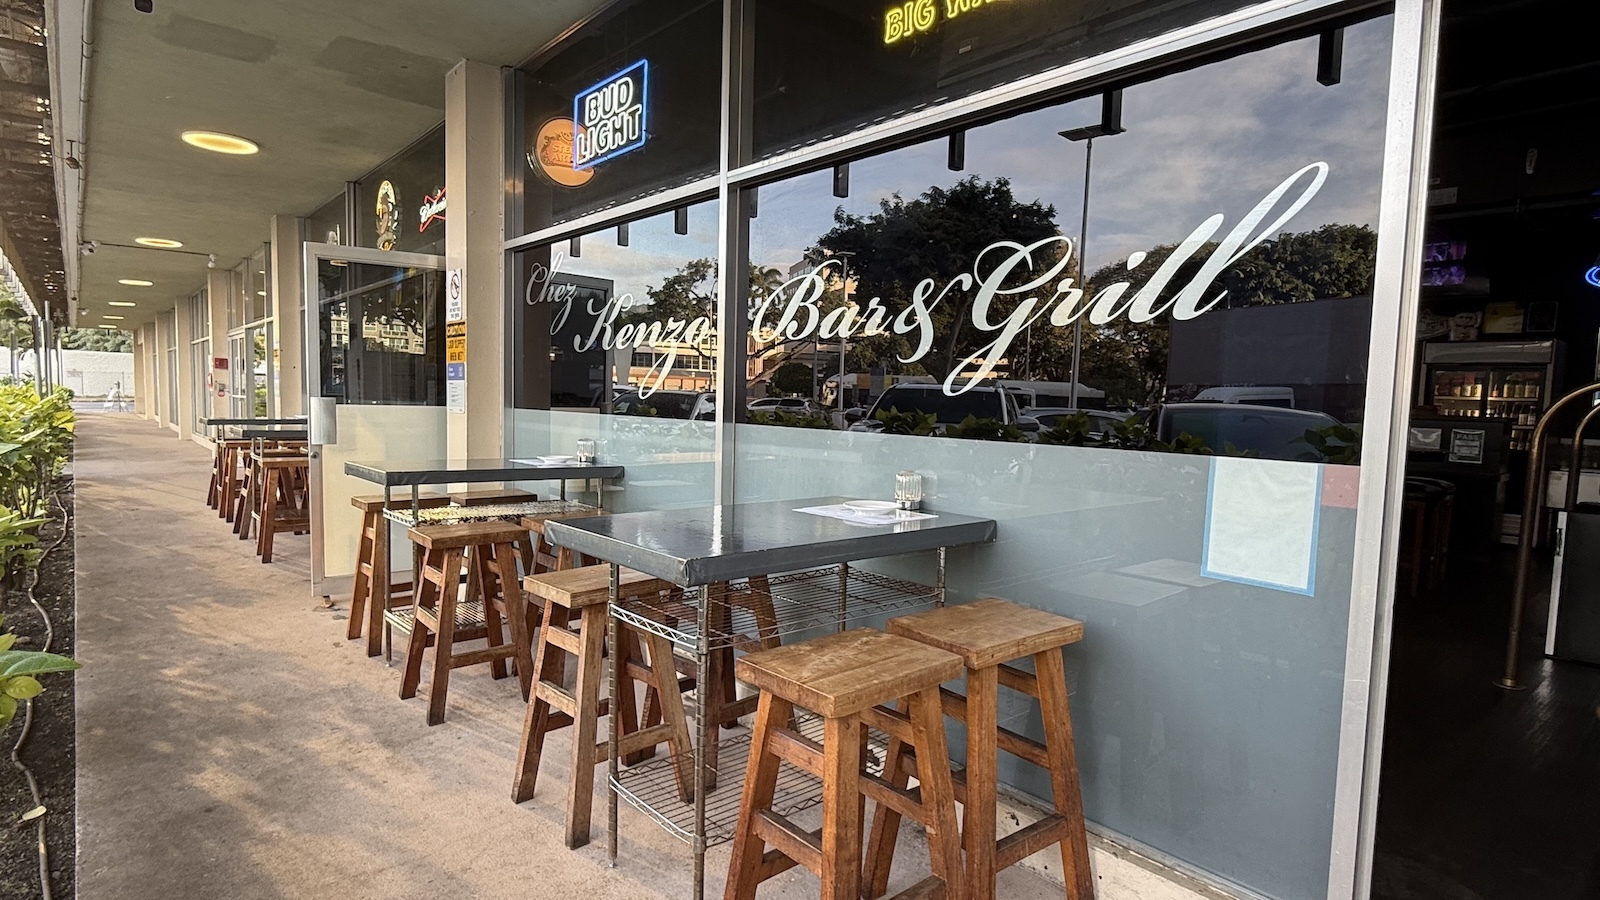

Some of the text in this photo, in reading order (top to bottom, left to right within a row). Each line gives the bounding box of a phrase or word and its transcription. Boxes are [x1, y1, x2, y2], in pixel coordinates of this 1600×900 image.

[884, 0, 936, 44] BIG
[584, 76, 634, 127] BUD
[576, 103, 643, 164] LIGHT
[525, 161, 1330, 400] Chez Kenzo Bar & Grill
[1455, 433, 1480, 442] PASS
